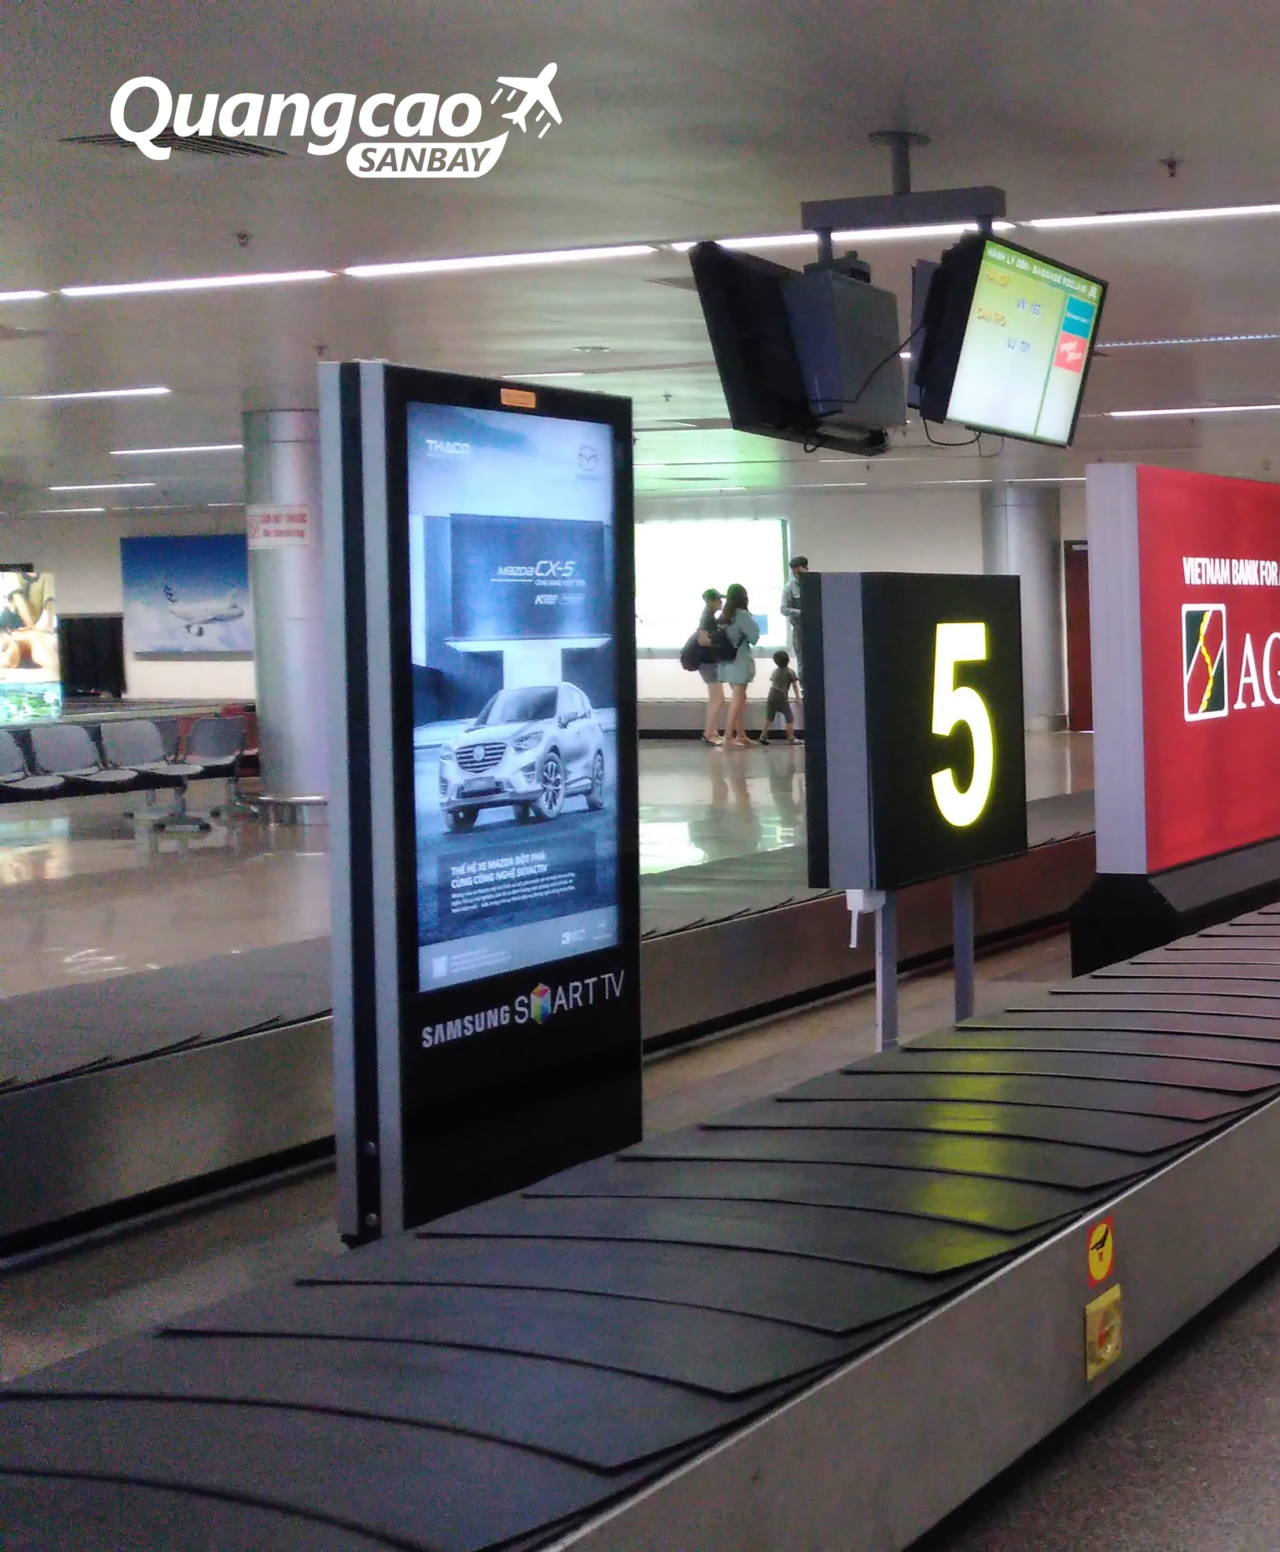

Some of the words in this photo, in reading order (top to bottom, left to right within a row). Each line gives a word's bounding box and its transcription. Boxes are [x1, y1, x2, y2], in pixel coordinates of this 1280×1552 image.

[425, 439, 471, 455] THACO
[534, 560, 577, 577] CX-5
[1182, 556, 1231, 586] VIETNAM
[1231, 558, 1260, 587] BANK
[1260, 559, 1279, 587] FOR
[930, 621, 994, 828] 5
[421, 1004, 511, 1049] SAMSUNG
[600, 969, 625, 1000] TV
